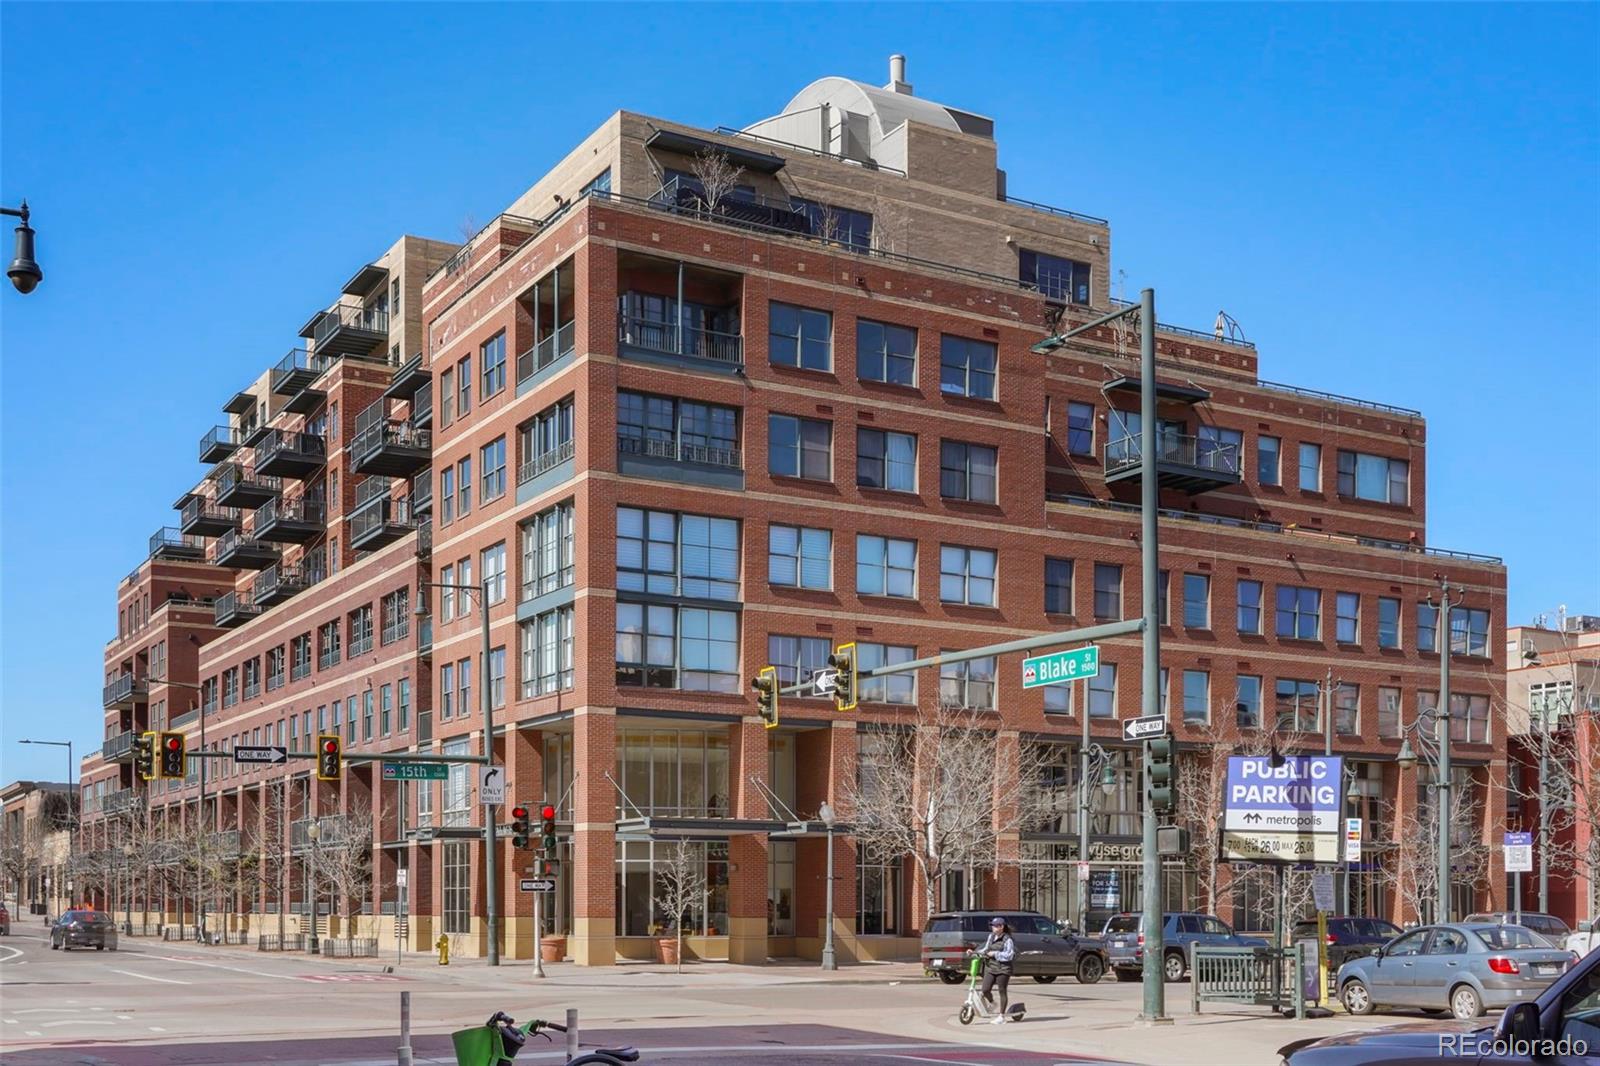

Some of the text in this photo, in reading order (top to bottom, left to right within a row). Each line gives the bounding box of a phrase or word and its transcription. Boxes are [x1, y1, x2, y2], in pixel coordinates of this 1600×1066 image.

[1040, 656, 1076, 680] Blake
[1135, 721, 1161, 732] ONE WAY
[400, 766, 427, 777] 15th
[1242, 760, 1328, 779] PUBLIC
[1232, 785, 1335, 805] PARKING
[1266, 815, 1322, 828] metropolis
[1281, 843, 1294, 851] MAX
